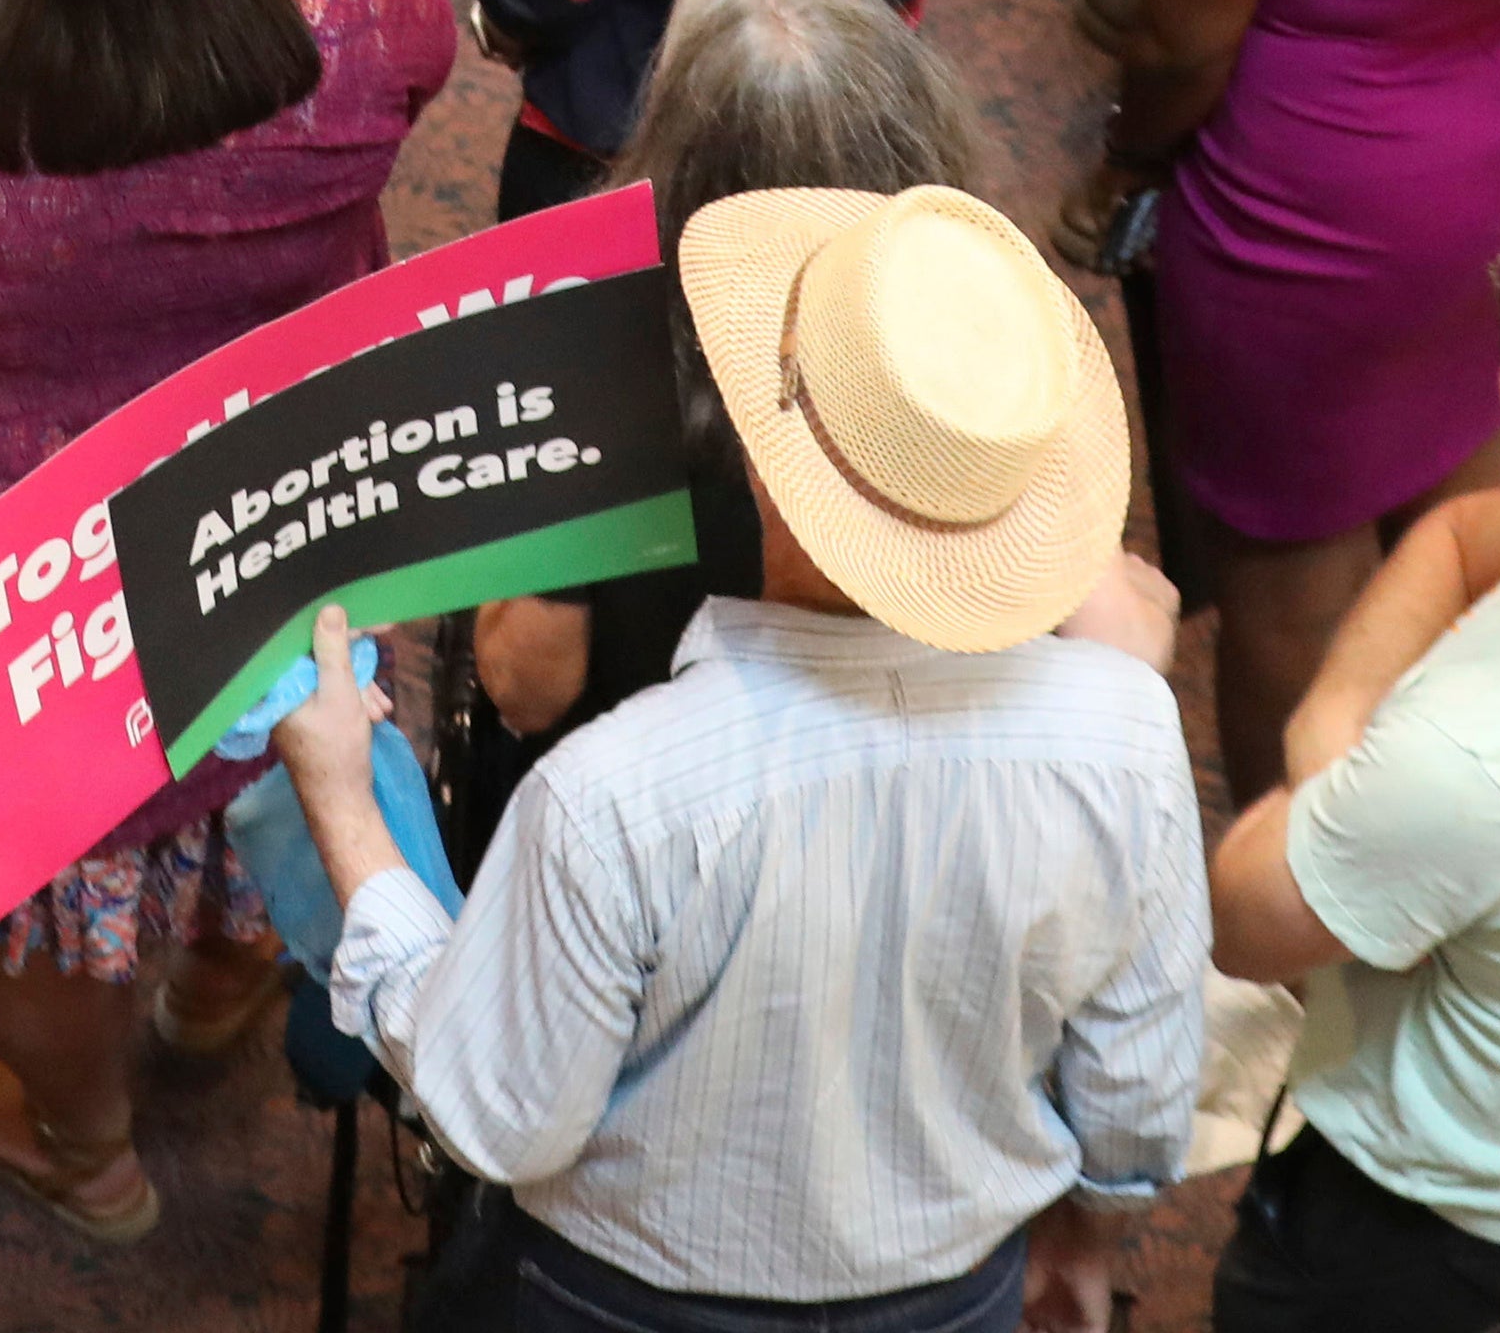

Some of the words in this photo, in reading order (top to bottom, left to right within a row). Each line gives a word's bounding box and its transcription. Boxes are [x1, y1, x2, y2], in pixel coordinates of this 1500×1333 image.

[189, 403, 479, 566] Abortion
[496, 381, 555, 428] is
[195, 477, 400, 616] Health
[416, 436, 602, 498] Care.
[6, 589, 136, 727] Fig
